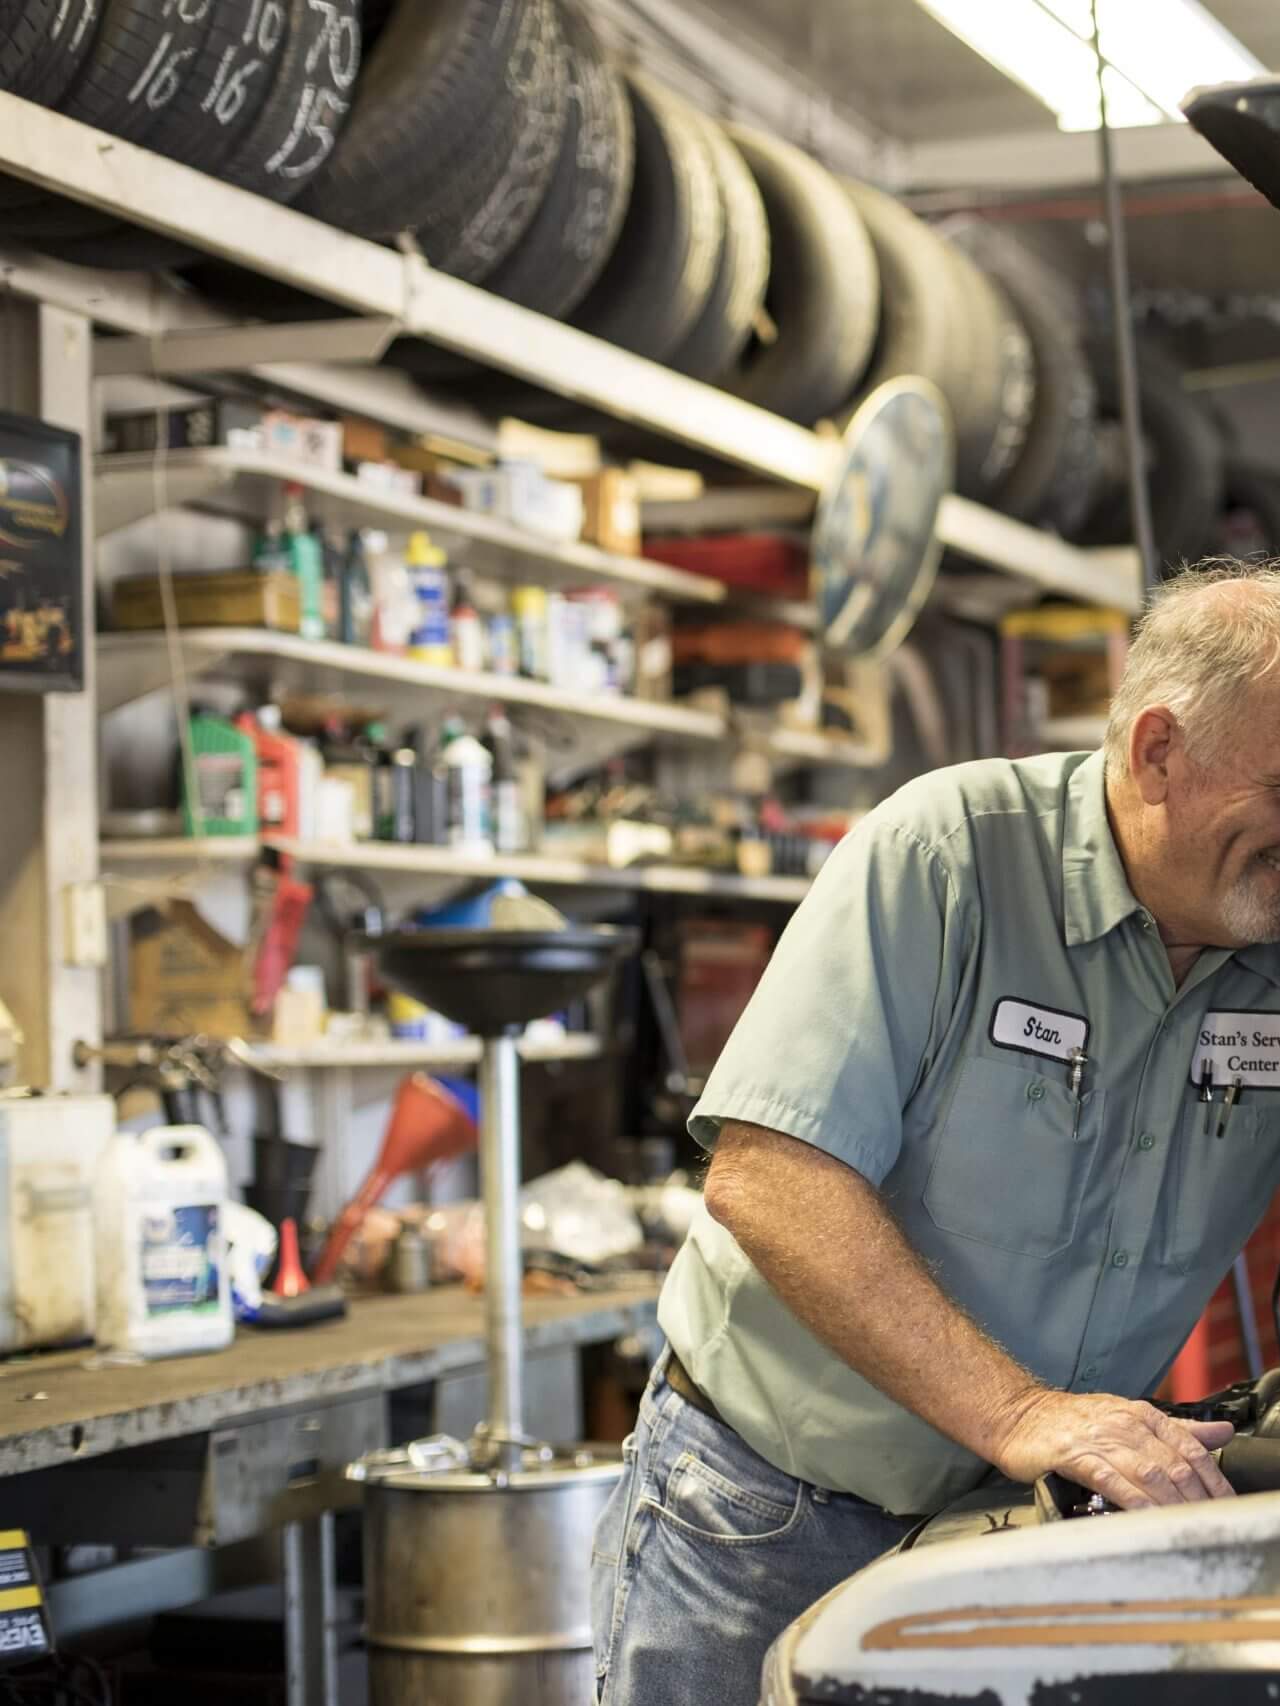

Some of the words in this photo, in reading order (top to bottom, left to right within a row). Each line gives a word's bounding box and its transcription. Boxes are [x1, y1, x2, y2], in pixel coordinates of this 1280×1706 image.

[127, 32, 198, 110] 16
[306, 0, 362, 90] 70
[201, 45, 263, 125] 16
[265, 83, 350, 179] 15
[1023, 1016, 1062, 1045] Stan
[1200, 1030, 1247, 1047] Stan's
[1227, 1055, 1279, 1073] Center
